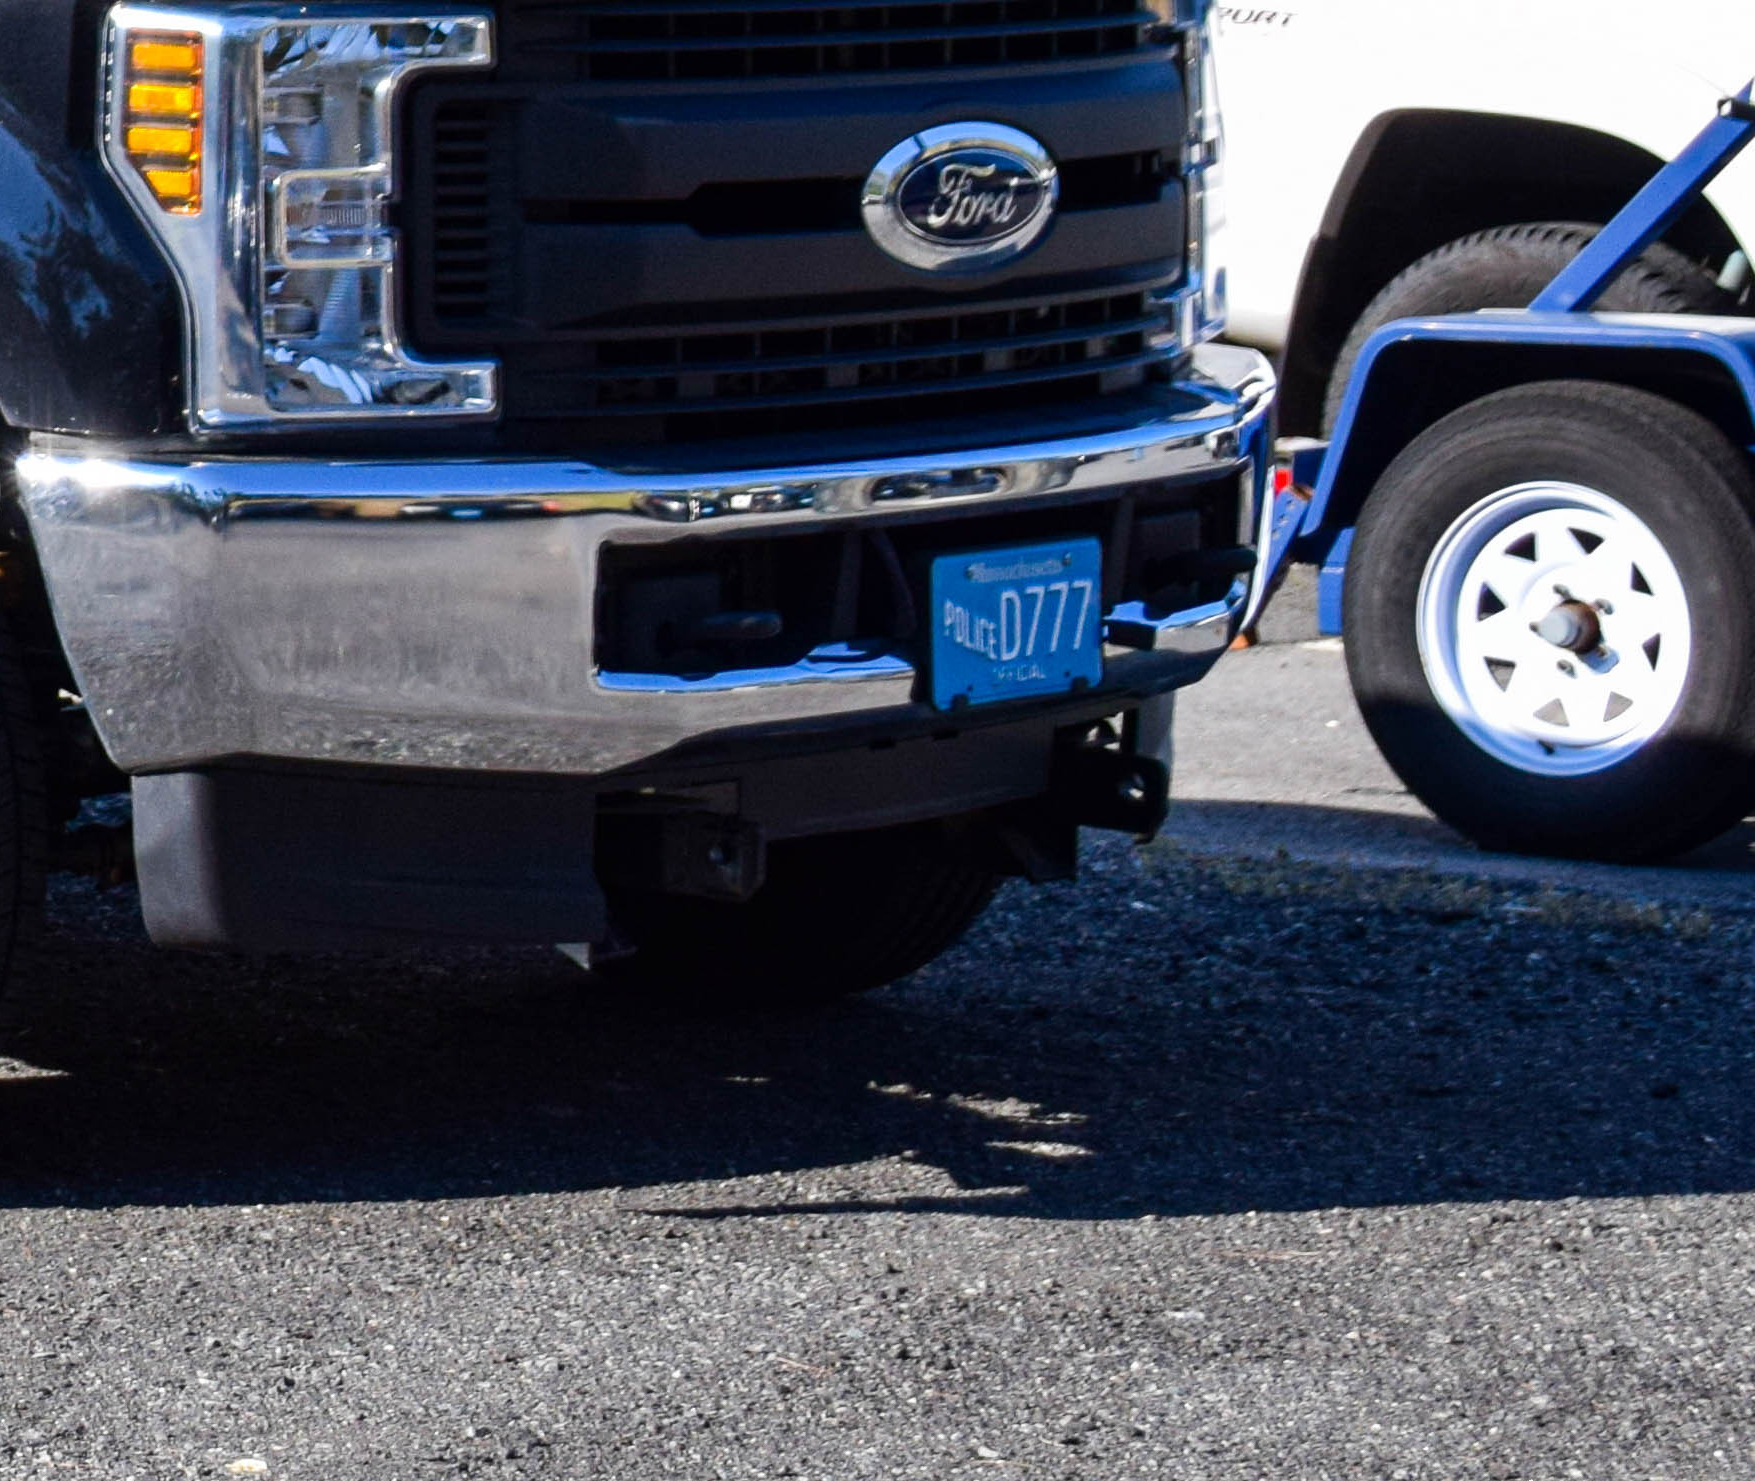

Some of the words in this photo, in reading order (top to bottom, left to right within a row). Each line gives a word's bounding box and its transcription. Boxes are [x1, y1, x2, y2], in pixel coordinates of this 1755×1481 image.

[926, 163, 1019, 229] Ford
[943, 597, 998, 661] POLICE
[1000, 579, 1093, 662] D777
